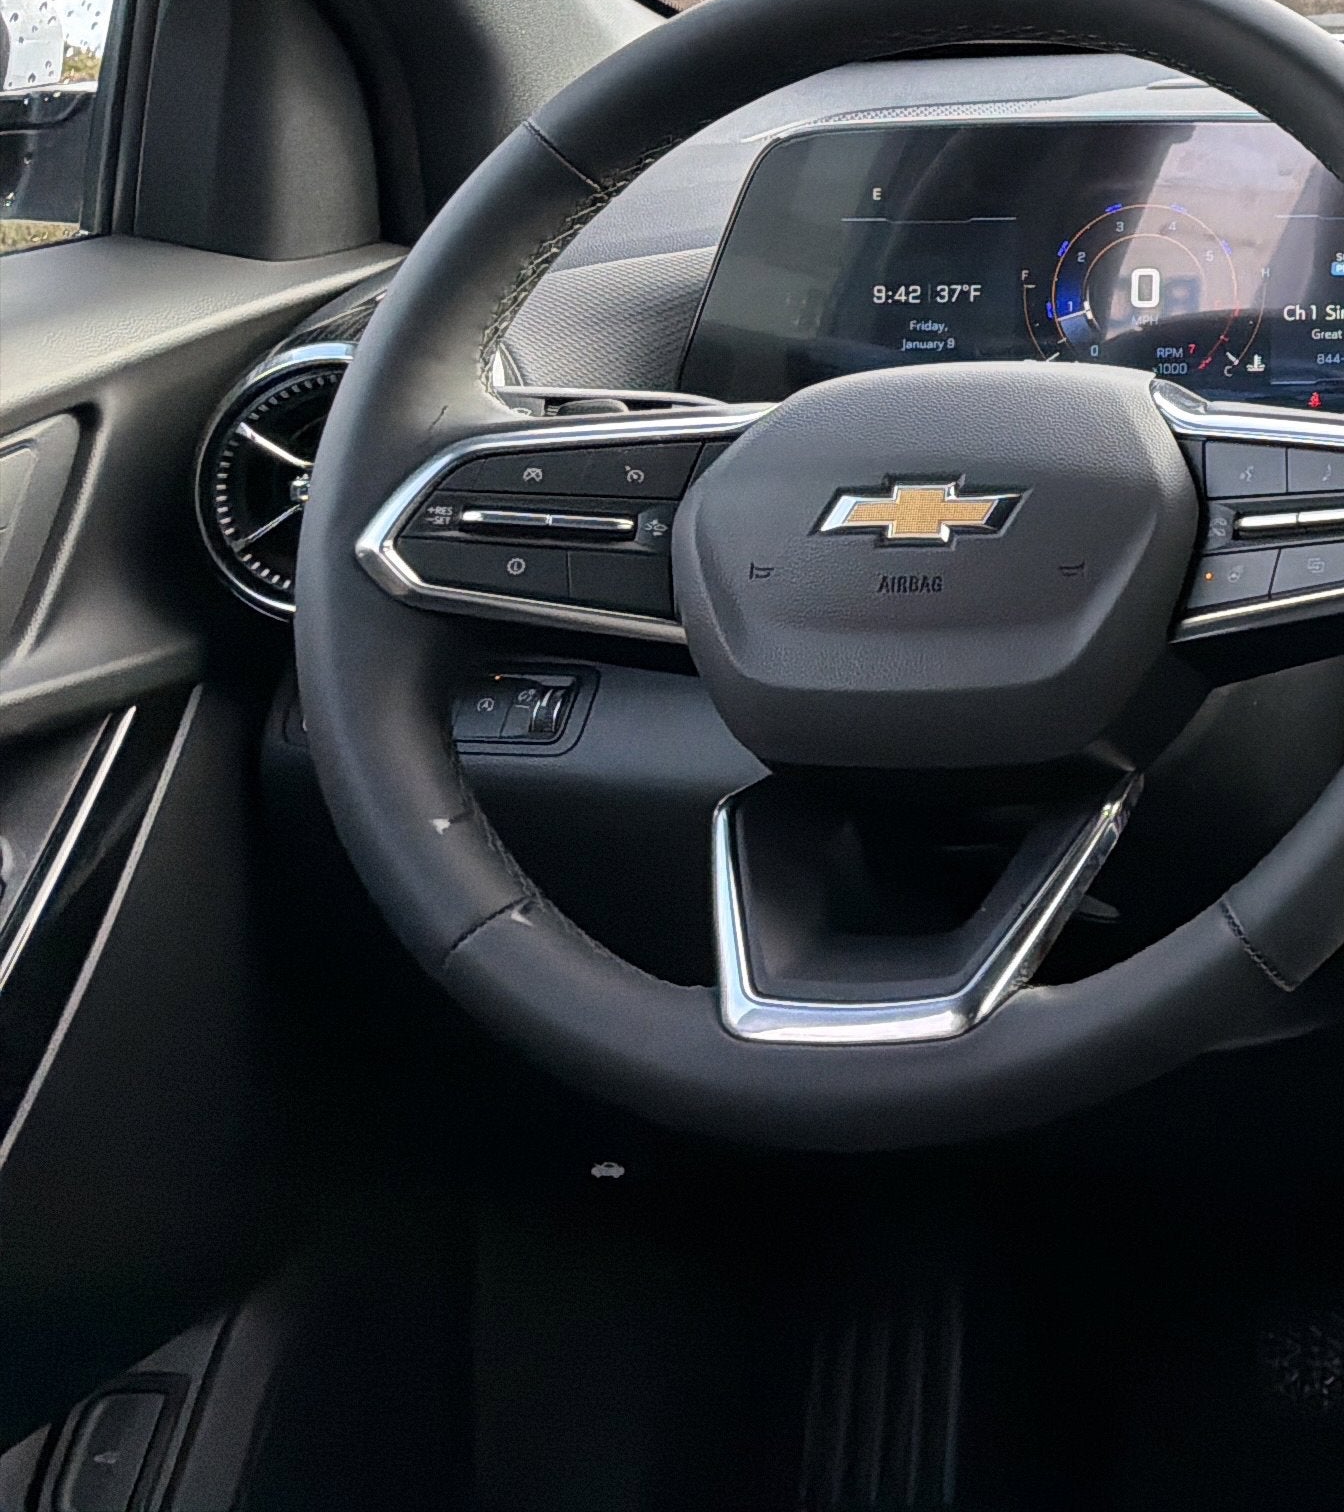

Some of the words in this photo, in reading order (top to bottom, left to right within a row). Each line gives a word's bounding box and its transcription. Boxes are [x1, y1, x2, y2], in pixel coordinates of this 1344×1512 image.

[872, 188, 882, 201] E
[1115, 222, 1125, 233] 3
[1168, 221, 1177, 231] 4
[1077, 252, 1086, 263] 2
[1205, 251, 1214, 262] 5
[1021, 269, 1030, 281] F
[873, 285, 921, 303] 9:42
[935, 284, 982, 303] 37°F
[1131, 268, 1160, 308] 0
[1283, 304, 1306, 321] Ch
[1310, 305, 1317, 320] 1
[909, 320, 948, 333] Friday,
[1132, 315, 1159, 326] MPH
[1311, 328, 1342, 340] Great
[901, 338, 945, 351] January
[947, 338, 955, 349] 9
[1188, 344, 1196, 355] 7
[1156, 347, 1184, 359] RPM
[878, 575, 943, 594] AIRBAG
